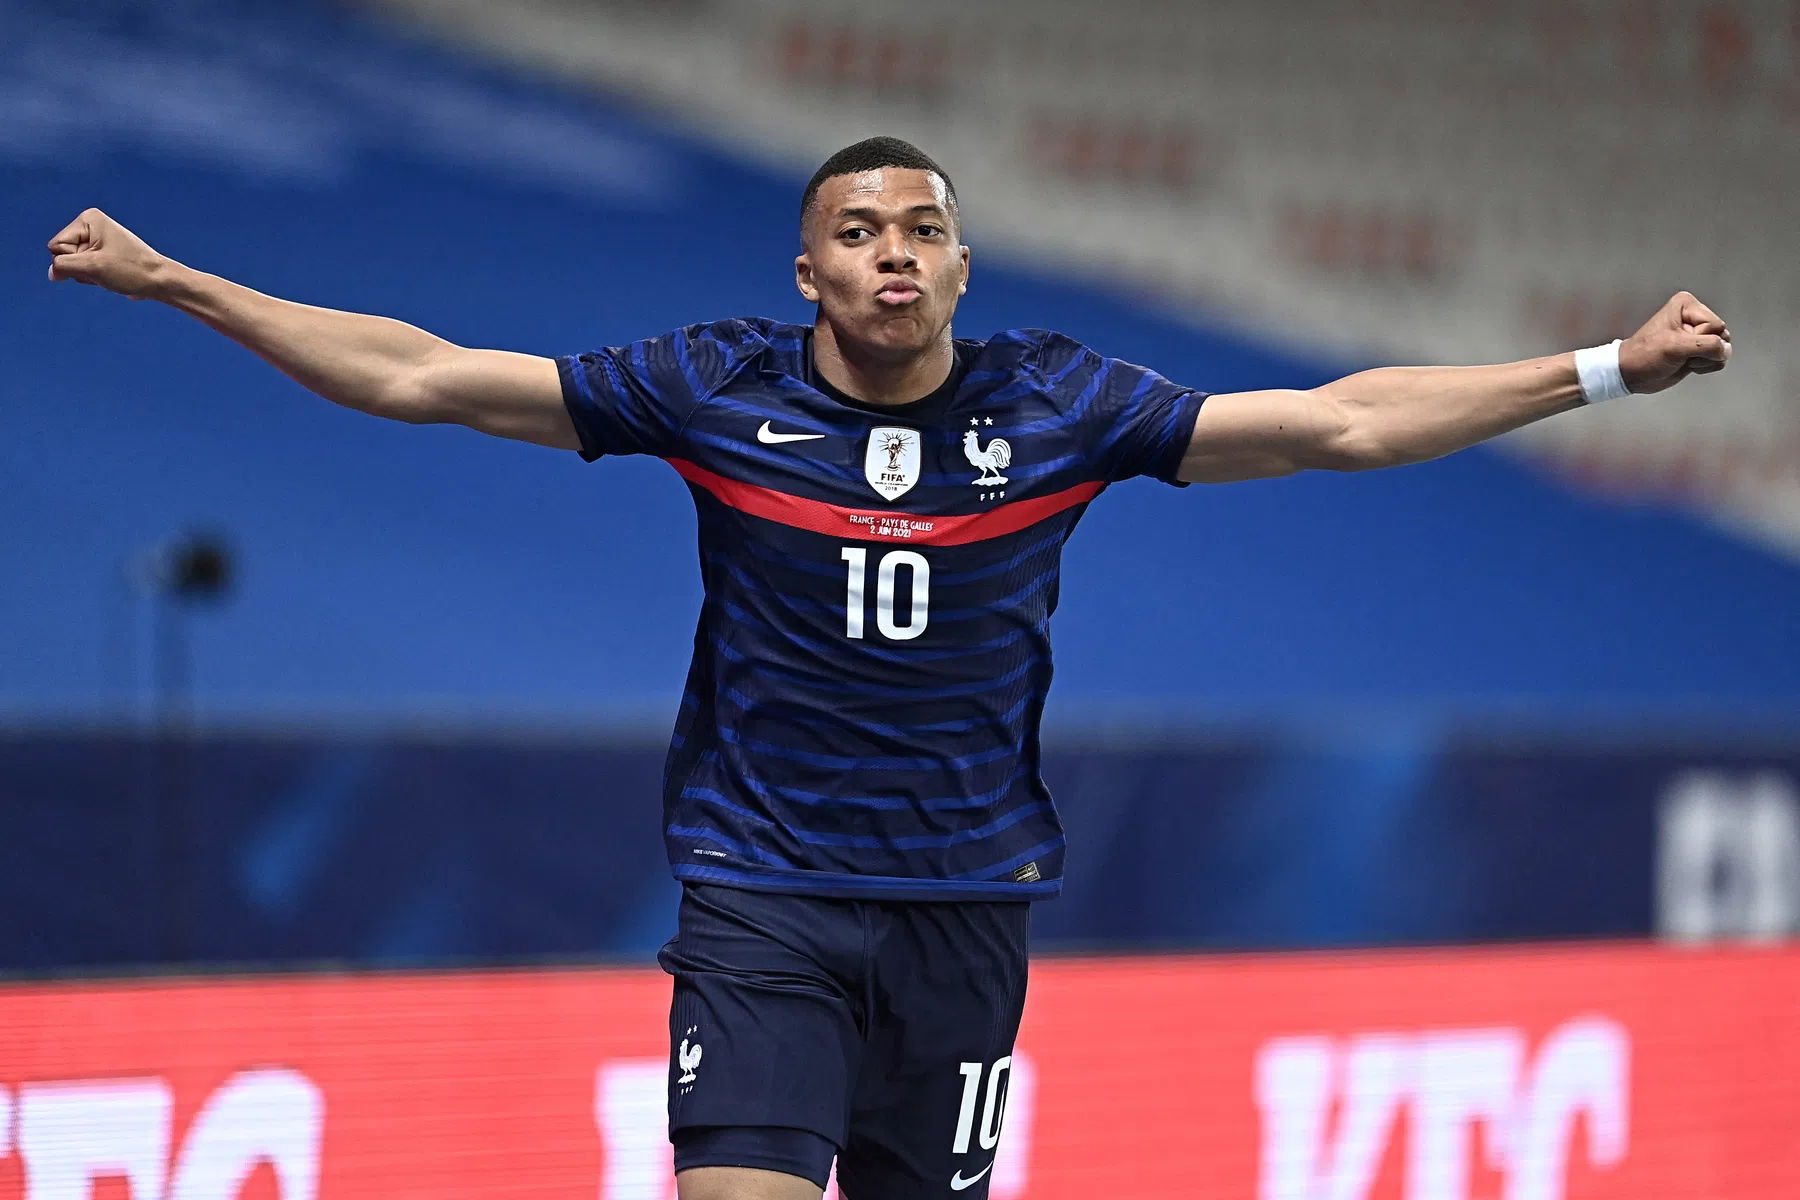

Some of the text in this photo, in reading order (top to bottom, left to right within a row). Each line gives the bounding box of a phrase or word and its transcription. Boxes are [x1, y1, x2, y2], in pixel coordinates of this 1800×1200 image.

[881, 473, 903, 482] FIFA
[849, 514, 875, 524] FRANCE
[881, 518, 899, 527] PAYS
[900, 519, 909, 529] DE
[910, 521, 933, 531] GALLES
[870, 525, 911, 538] 2 JUIN 2021
[841, 547, 930, 640] 10
[952, 1055, 1011, 1153] 10
